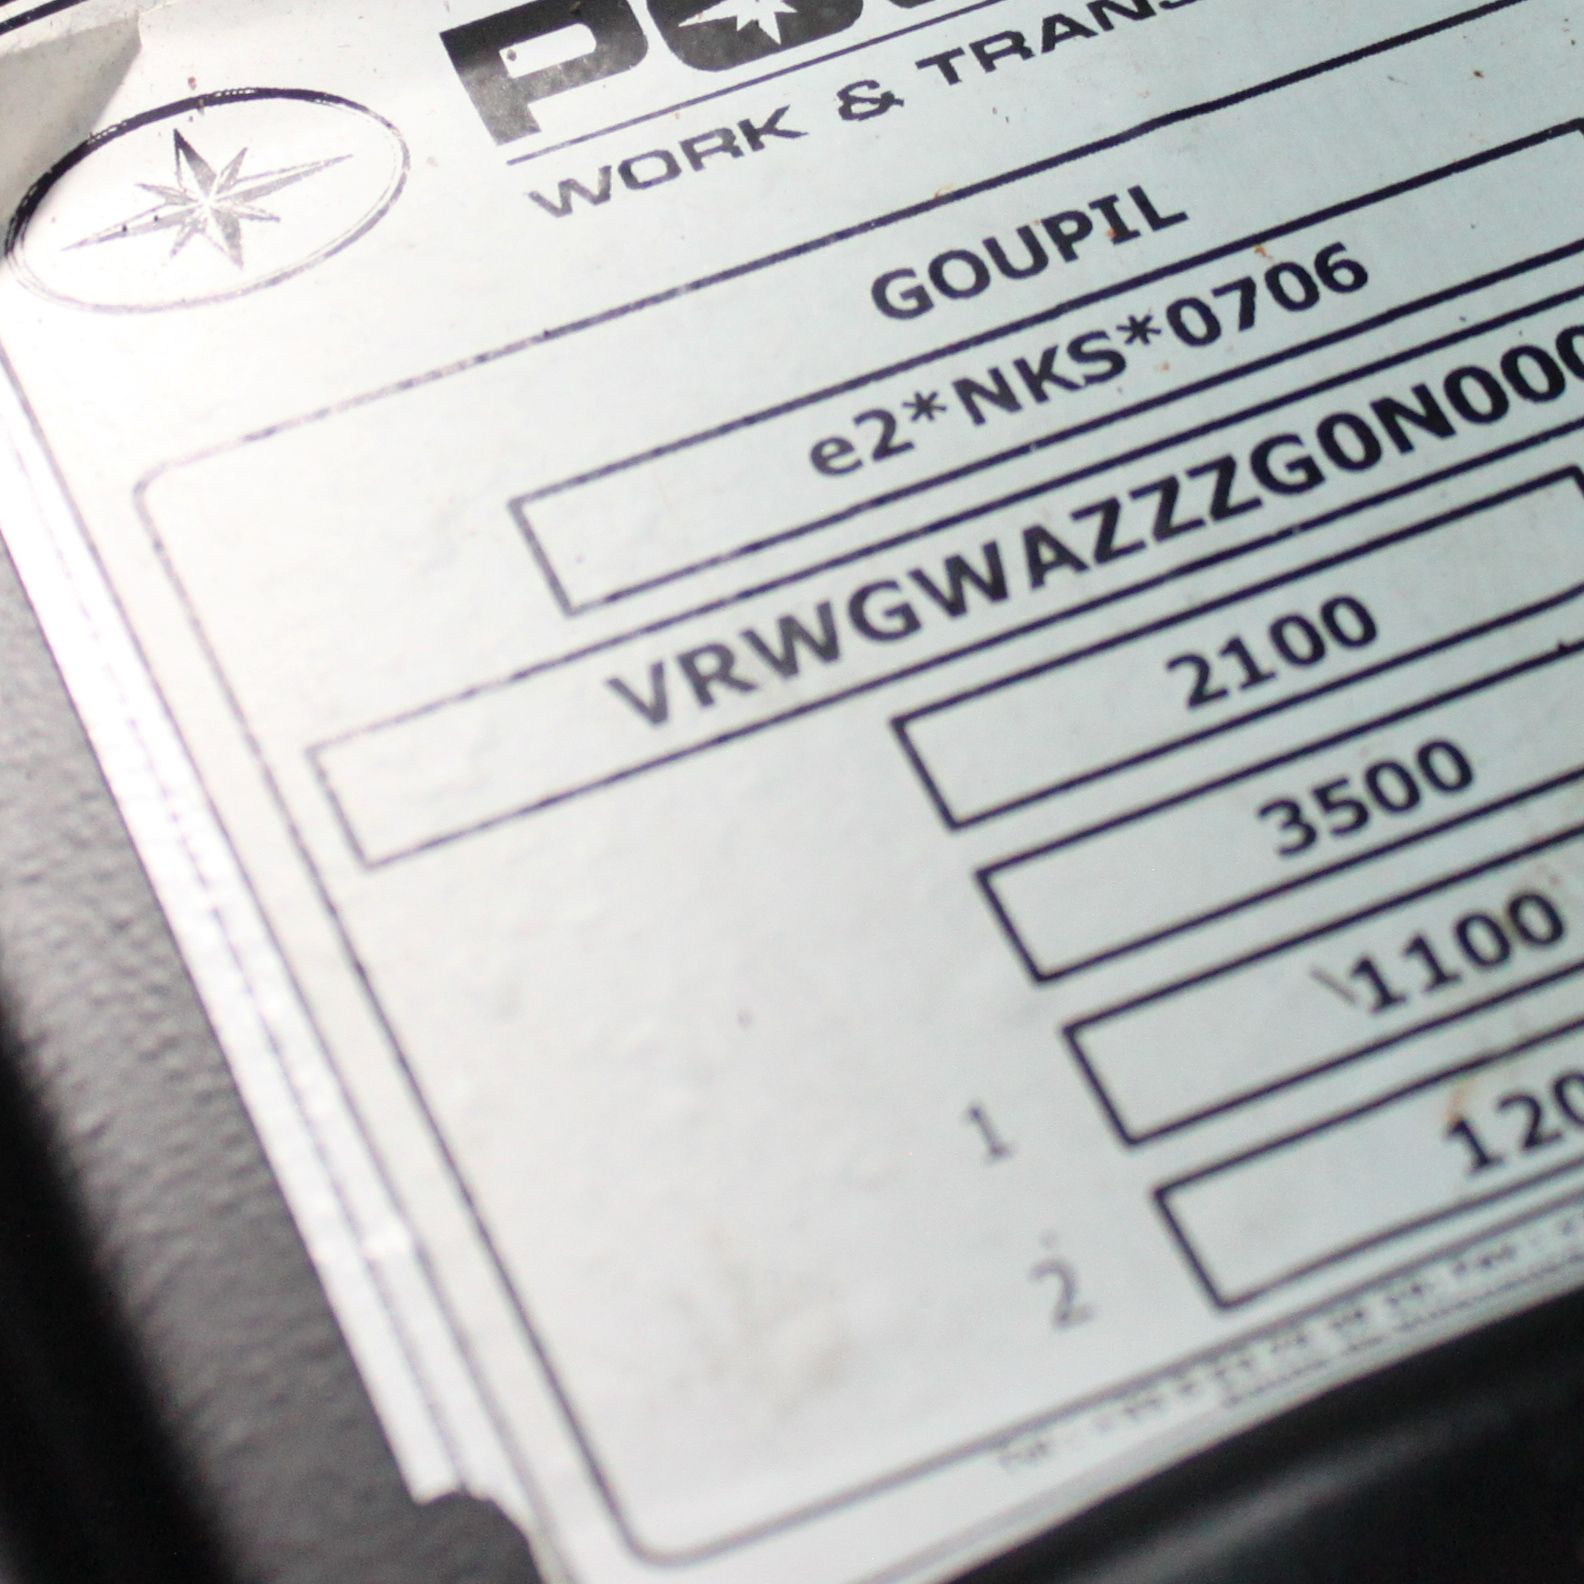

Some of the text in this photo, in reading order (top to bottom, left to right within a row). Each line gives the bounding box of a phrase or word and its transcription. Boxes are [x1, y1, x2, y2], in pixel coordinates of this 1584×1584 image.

[526, 100, 807, 217] WORK
[836, 76, 907, 123] &
[870, 181, 1191, 322] GOUPIL
[1165, 592, 1379, 710] 2100
[1256, 738, 1475, 859] 3500
[961, 888, 1565, 1167] 1 1100
[1029, 1257, 1096, 1331] 2
